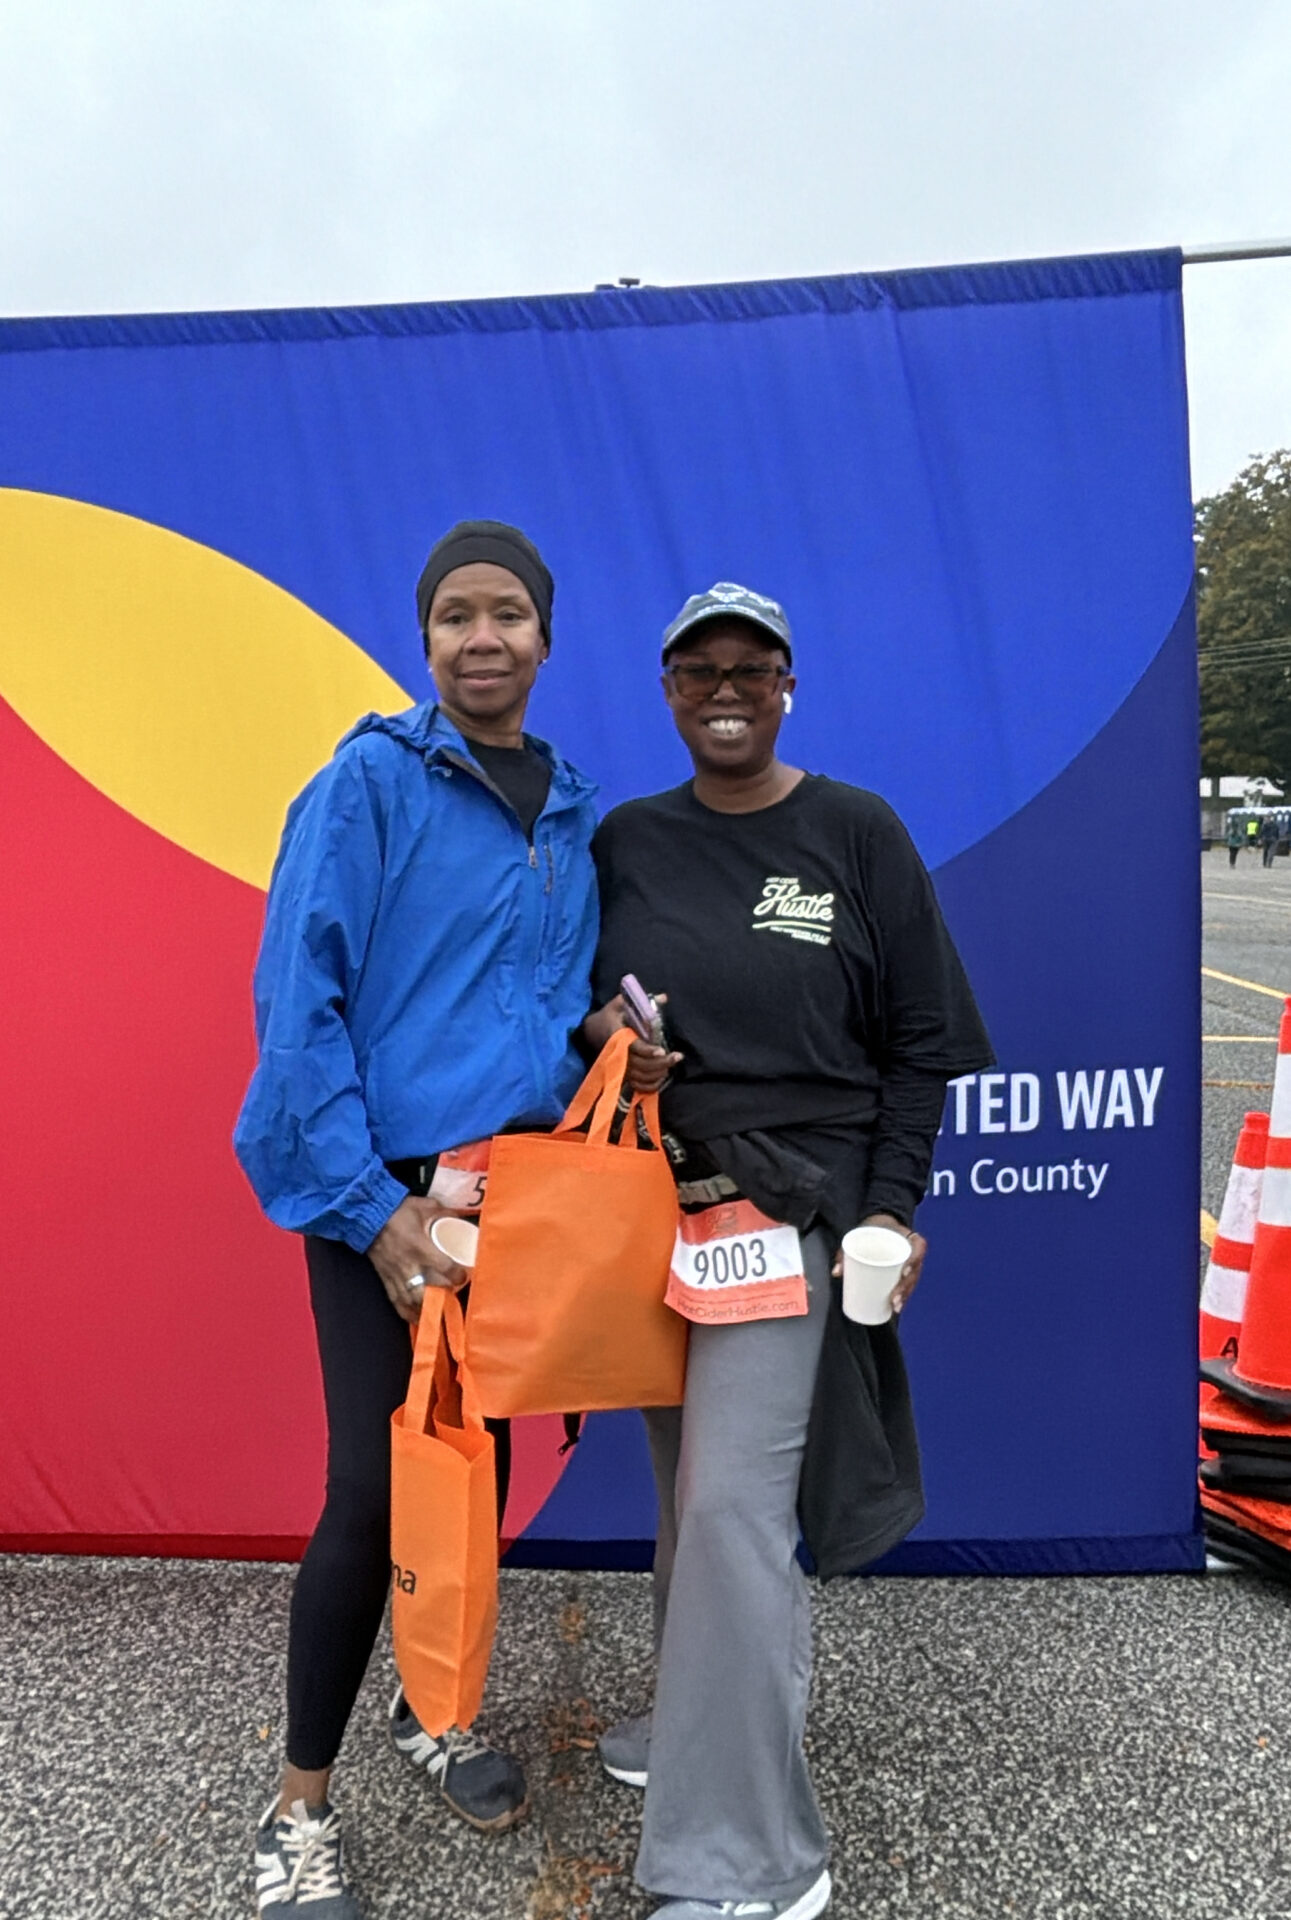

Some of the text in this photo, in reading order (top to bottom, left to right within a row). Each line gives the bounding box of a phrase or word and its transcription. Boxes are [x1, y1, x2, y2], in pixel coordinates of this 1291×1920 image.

[753, 883, 834, 921] Hustle
[937, 1066, 1165, 1136] TED WAY
[466, 1175, 488, 1208] 5
[925, 1157, 1110, 1200] n County
[693, 1237, 768, 1285] 9003
